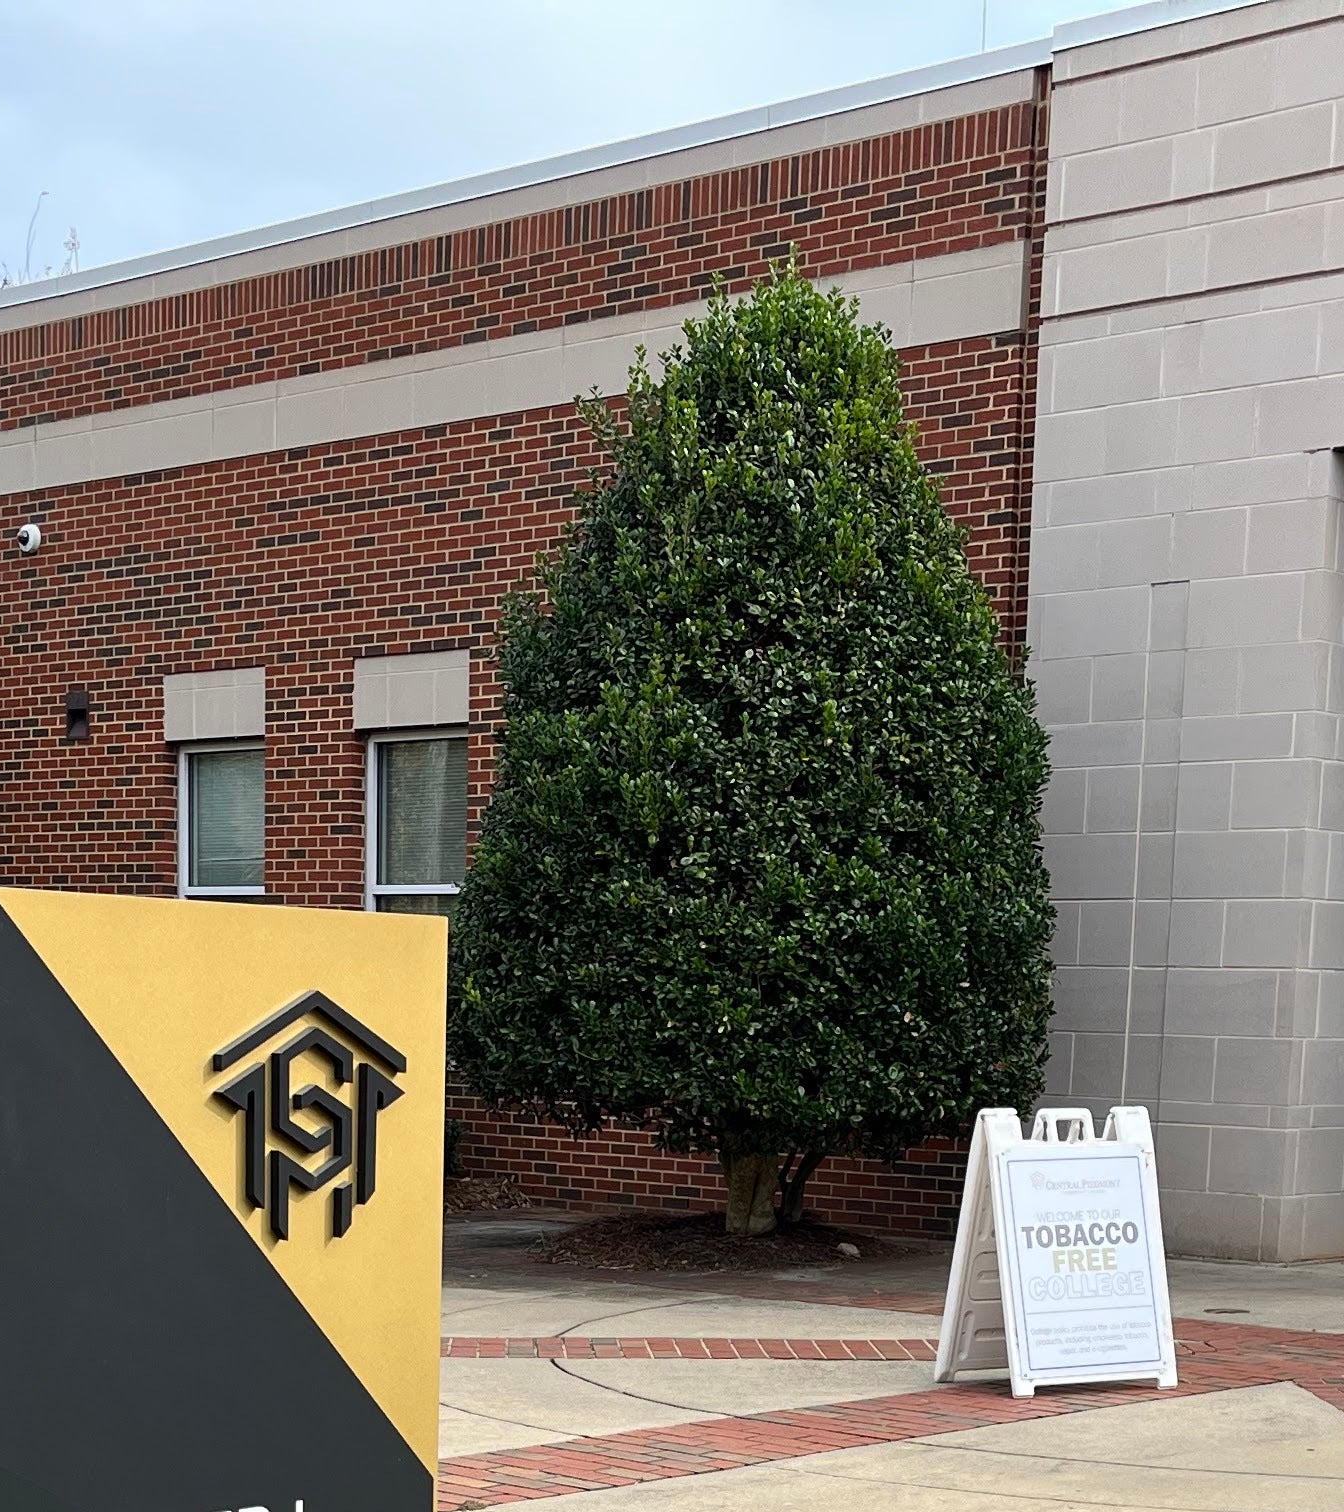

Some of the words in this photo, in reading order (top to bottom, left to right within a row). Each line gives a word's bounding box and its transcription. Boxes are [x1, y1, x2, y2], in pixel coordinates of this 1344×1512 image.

[1036, 1211, 1084, 1223] WELCOME
[1087, 1210, 1100, 1220] TO
[1101, 1208, 1121, 1220] OUR
[1021, 1221, 1139, 1249] TOBACCO
[1052, 1248, 1118, 1273] FREE
[1028, 1271, 1146, 1302] COLLEGE
